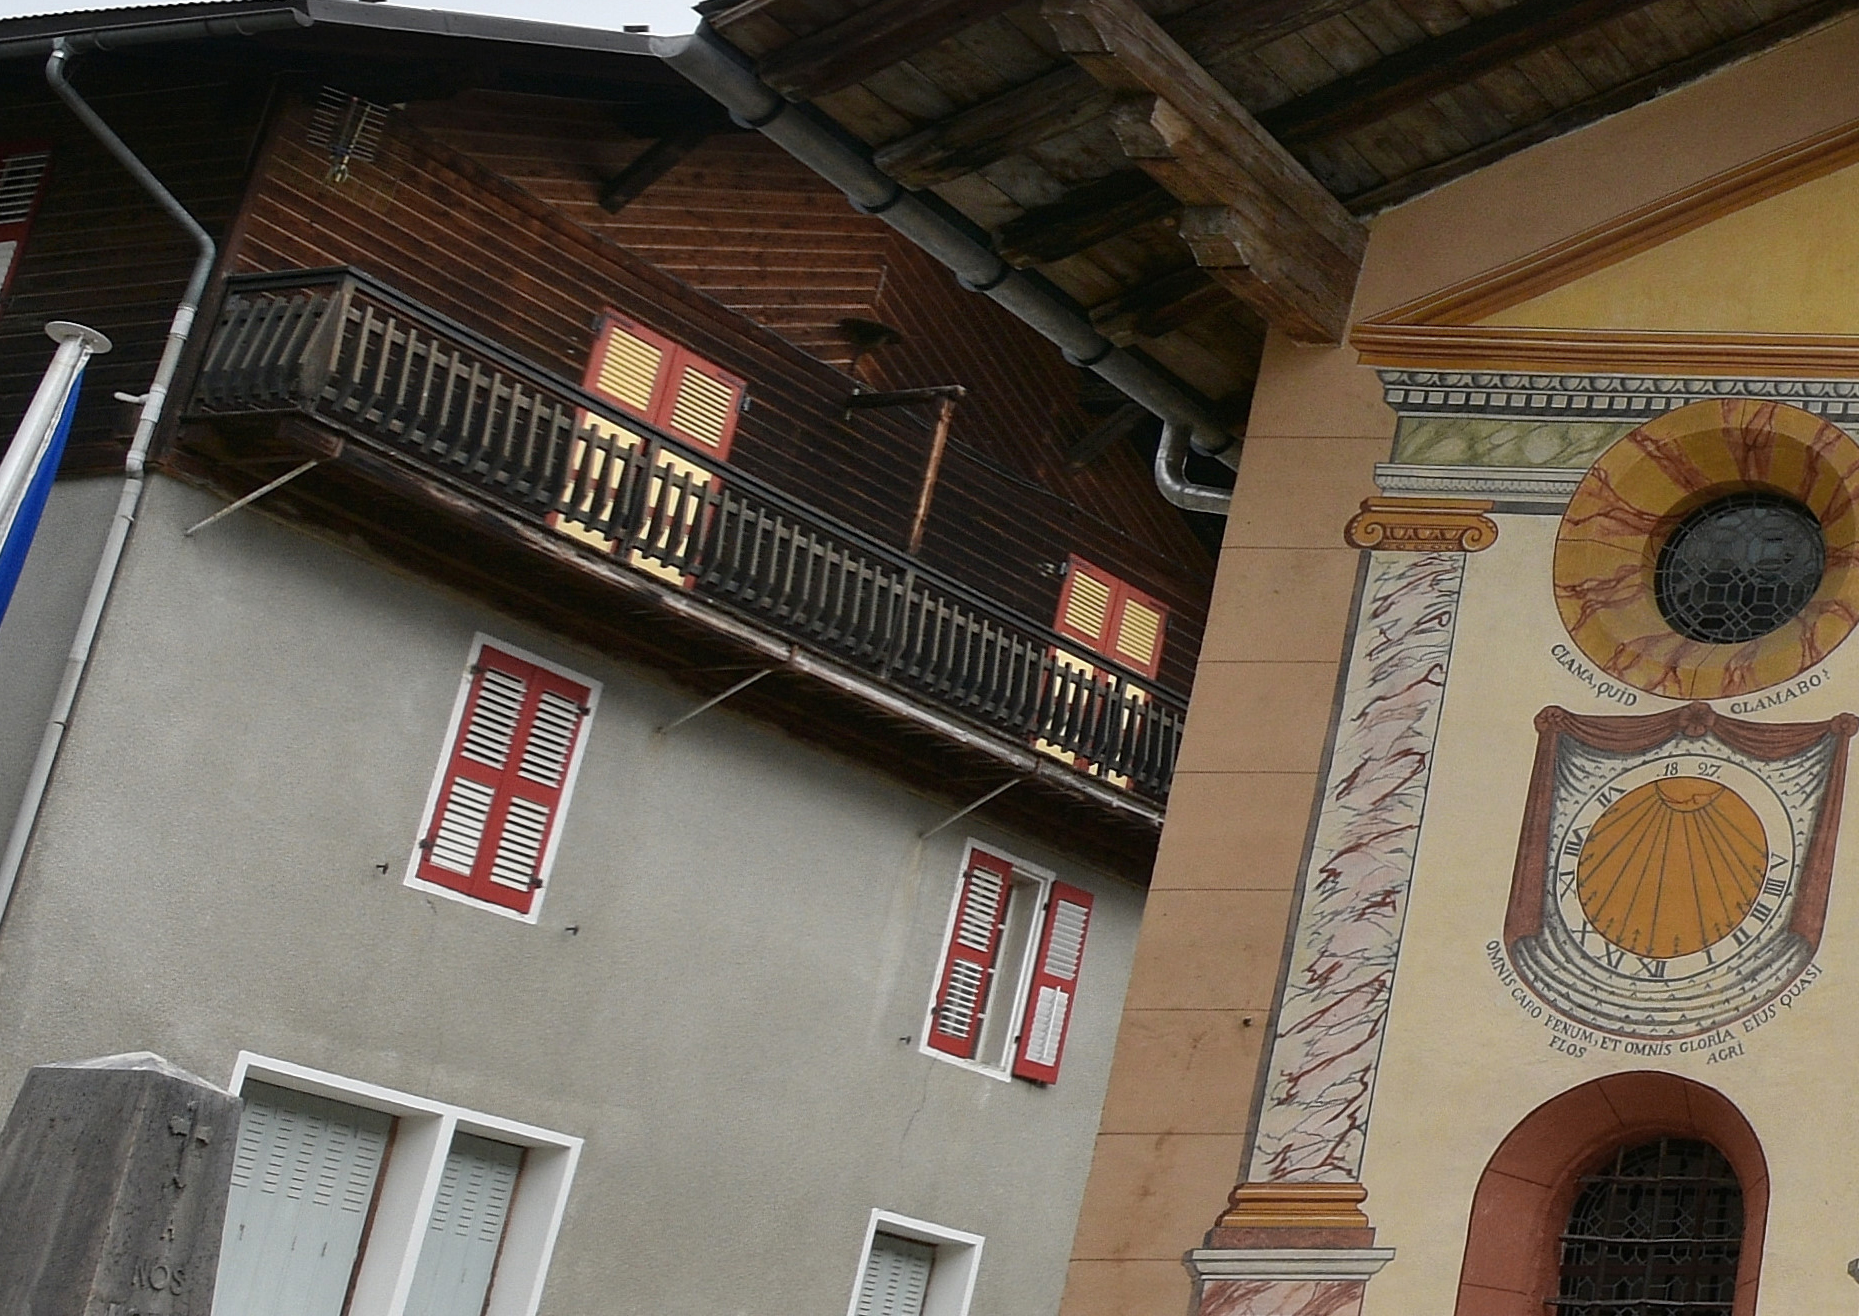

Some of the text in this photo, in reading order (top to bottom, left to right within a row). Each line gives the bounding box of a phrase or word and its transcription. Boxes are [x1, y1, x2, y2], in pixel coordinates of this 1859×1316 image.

[1595, 681, 1638, 707] QUID
[1510, 986, 1543, 1021] CARO
[1600, 1038, 1621, 1052] ET
[1548, 1035, 1587, 1059] FLOS
